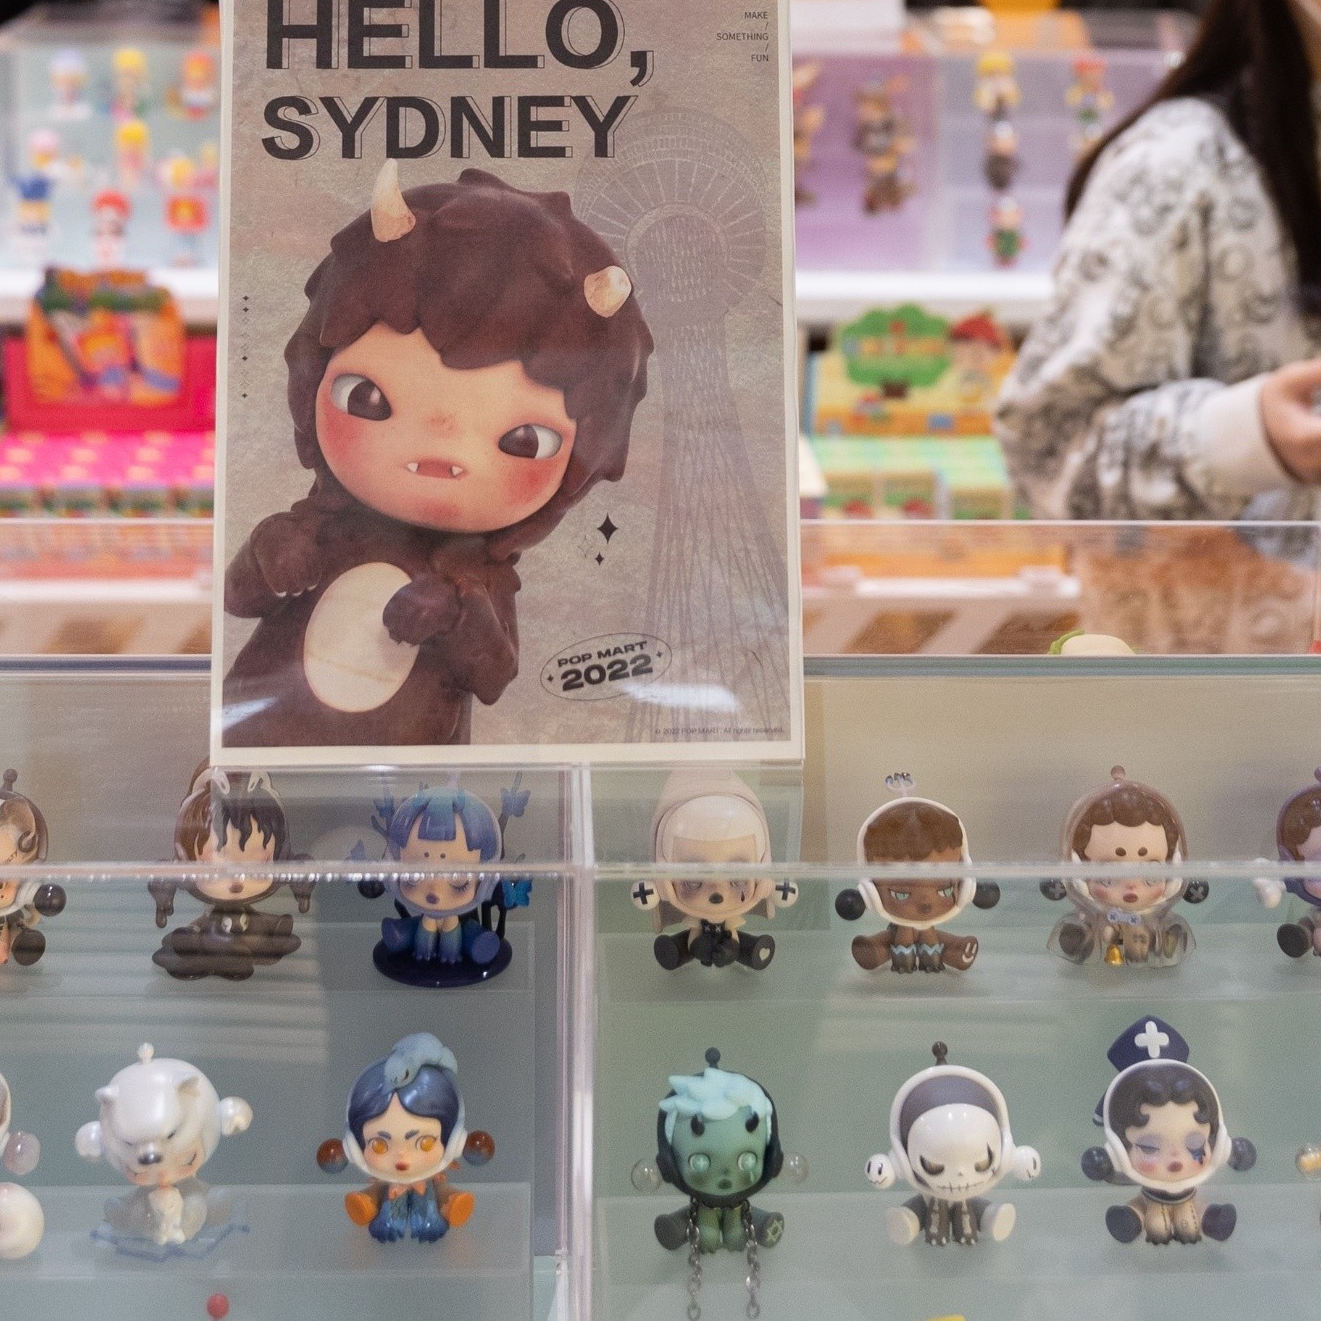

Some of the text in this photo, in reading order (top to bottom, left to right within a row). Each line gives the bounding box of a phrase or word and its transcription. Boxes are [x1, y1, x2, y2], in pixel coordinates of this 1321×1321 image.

[744, 11, 769, 20] MAKE
[716, 32, 769, 42] SOMETHING
[751, 54, 769, 63] FUN
[260, 95, 640, 164] SYDNEY
[557, 640, 648, 668] POP MART
[560, 653, 654, 692] 2022
